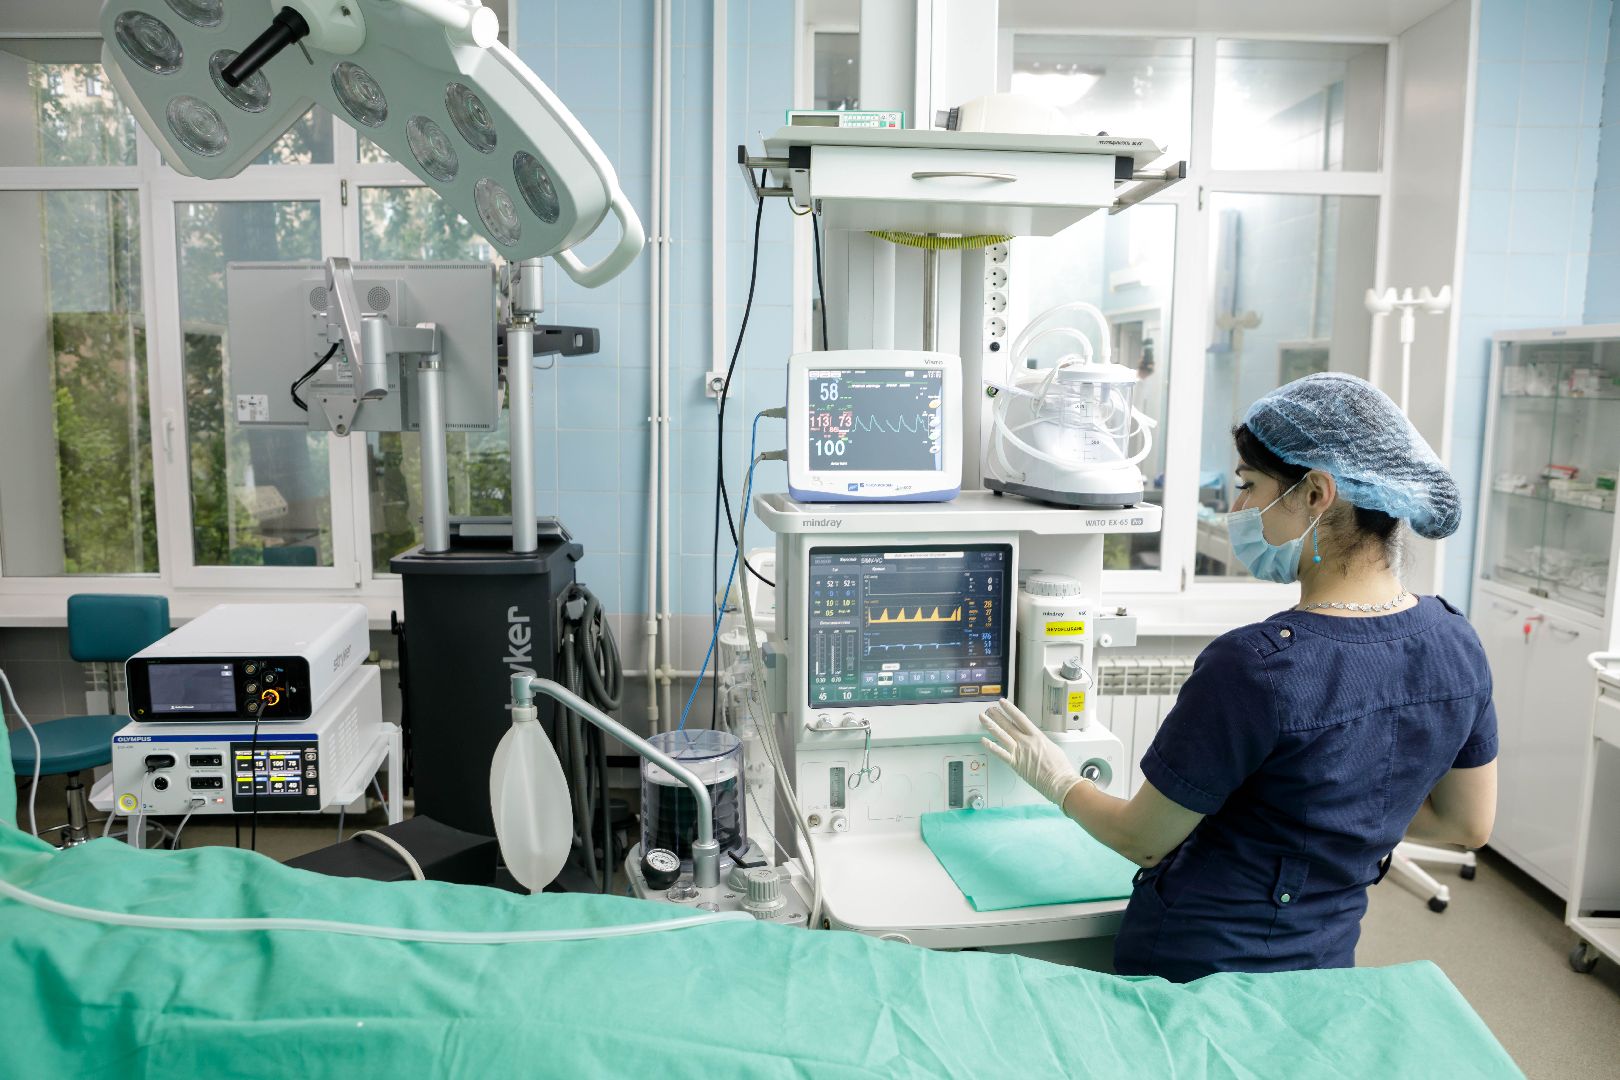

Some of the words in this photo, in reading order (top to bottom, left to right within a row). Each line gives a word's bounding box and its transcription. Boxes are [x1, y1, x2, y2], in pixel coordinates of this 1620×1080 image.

[820, 383, 838, 400] 58
[810, 416, 830, 427] 113
[839, 416, 852, 427] 73
[816, 440, 845, 456] 100
[802, 518, 842, 528] mindray
